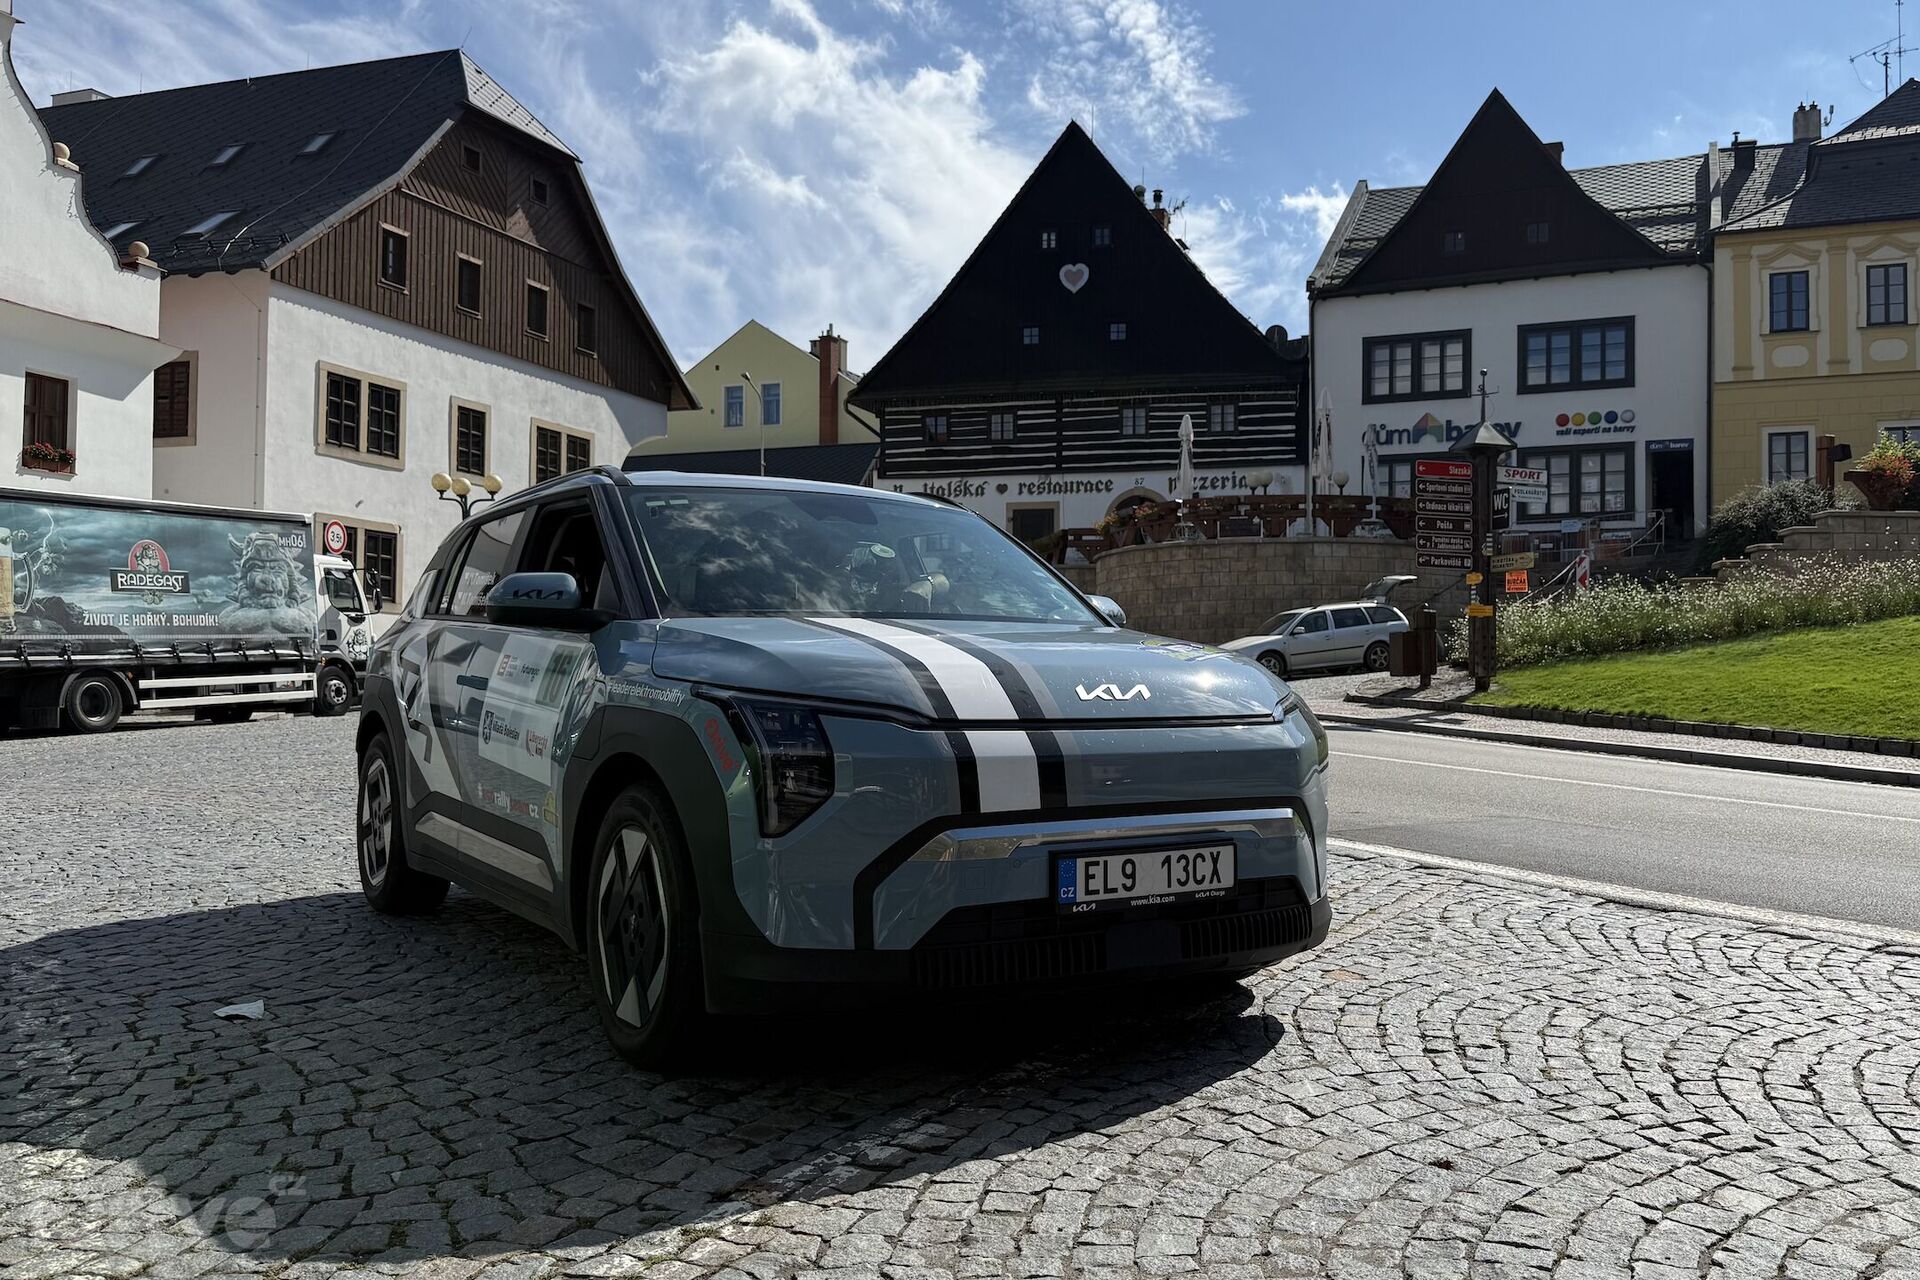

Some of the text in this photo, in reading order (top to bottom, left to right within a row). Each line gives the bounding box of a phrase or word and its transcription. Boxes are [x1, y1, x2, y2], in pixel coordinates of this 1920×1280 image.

[1602, 426, 1612, 434] na
[1504, 469, 1543, 480] SPORT
[1493, 493, 1509, 511] WC
[117, 573, 185, 592] RADEGAST
[82, 611, 219, 627] ŽIVOT JE HOŘKÝ. BOHUDÍK!
[1075, 683, 1151, 701] KIA
[1084, 850, 1222, 897] EL9 13CX
[1060, 887, 1075, 898] CZ
[1130, 894, 1176, 907] www.kia.com
